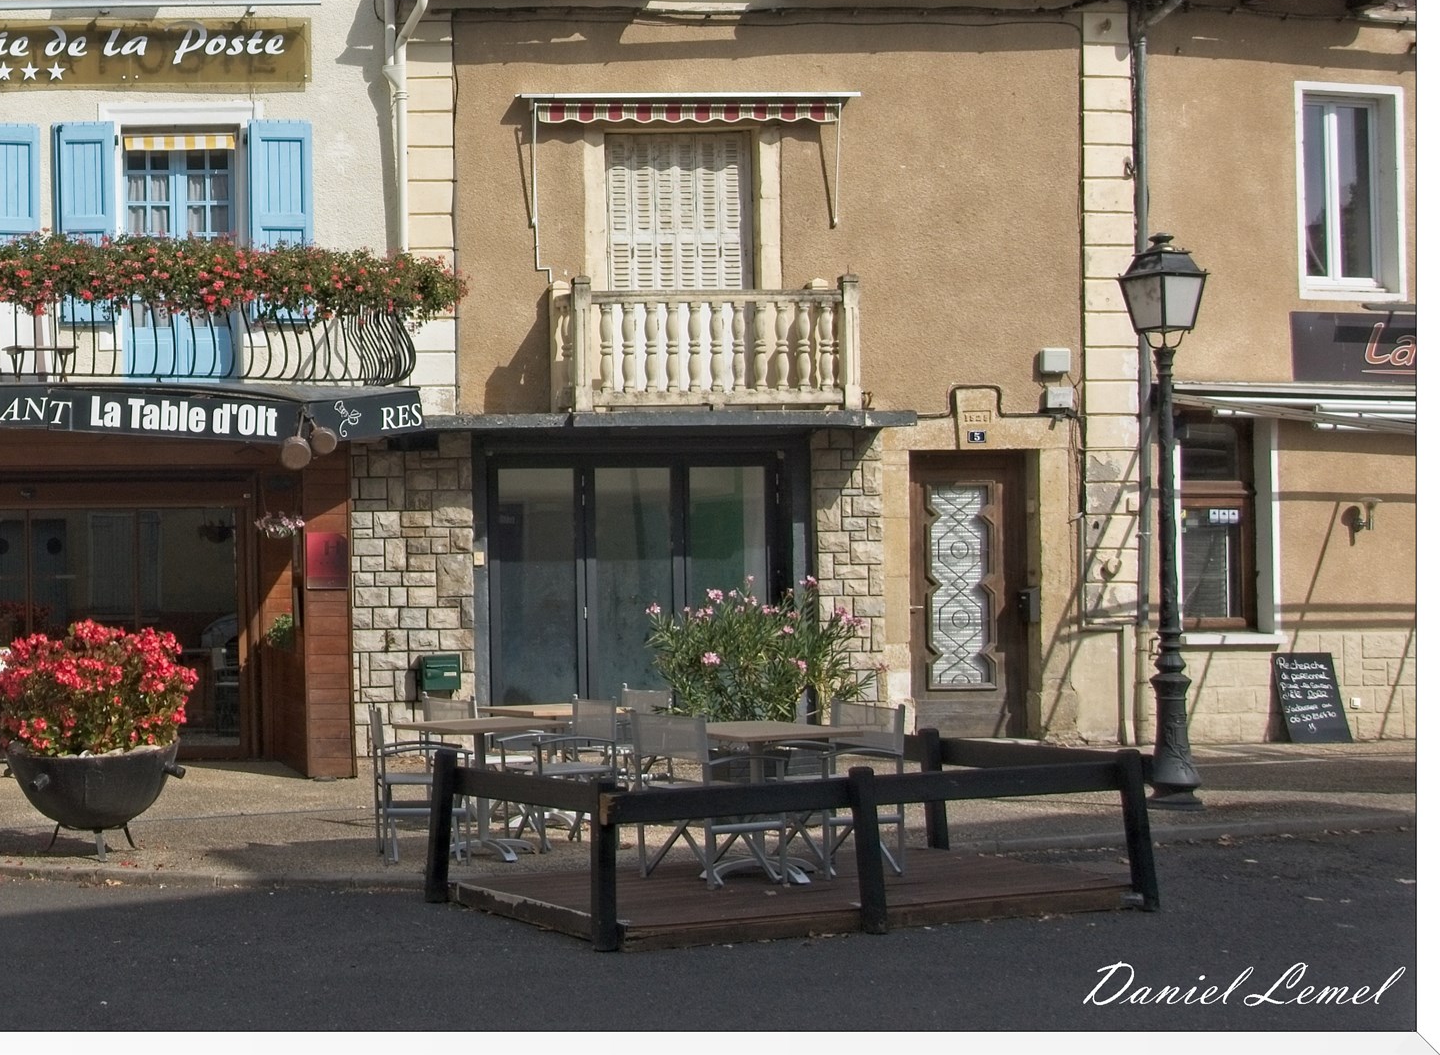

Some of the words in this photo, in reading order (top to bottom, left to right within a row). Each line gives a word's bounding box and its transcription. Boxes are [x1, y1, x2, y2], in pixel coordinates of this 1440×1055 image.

[44, 26, 88, 57] de
[103, 28, 148, 57] la
[163, 20, 285, 65] Poste
[1364, 321, 1417, 367] La
[90, 395, 122, 428] La
[127, 397, 207, 433] Table
[212, 403, 278, 437] d'Olt
[380, 403, 423, 431] RES
[973, 432, 981, 442] 5
[1276, 656, 1328, 670] Recherche
